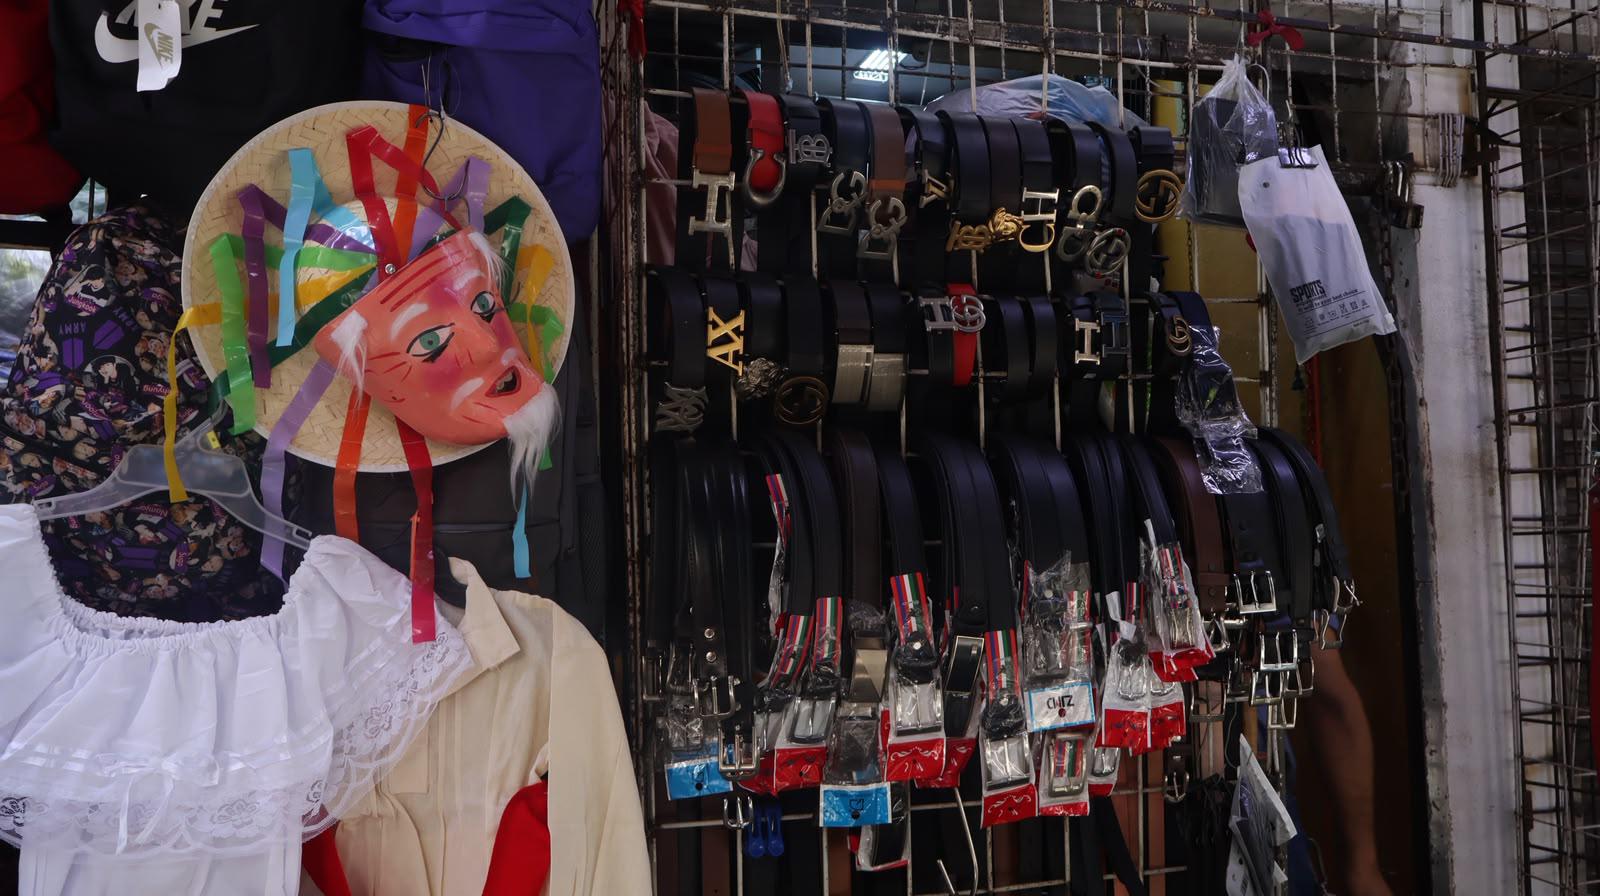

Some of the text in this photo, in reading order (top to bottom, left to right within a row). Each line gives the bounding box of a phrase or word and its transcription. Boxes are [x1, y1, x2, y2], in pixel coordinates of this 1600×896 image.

[157, 31, 174, 65] NIKE
[1290, 280, 1327, 303] SPORTS
[59, 321, 87, 336] ARMY
